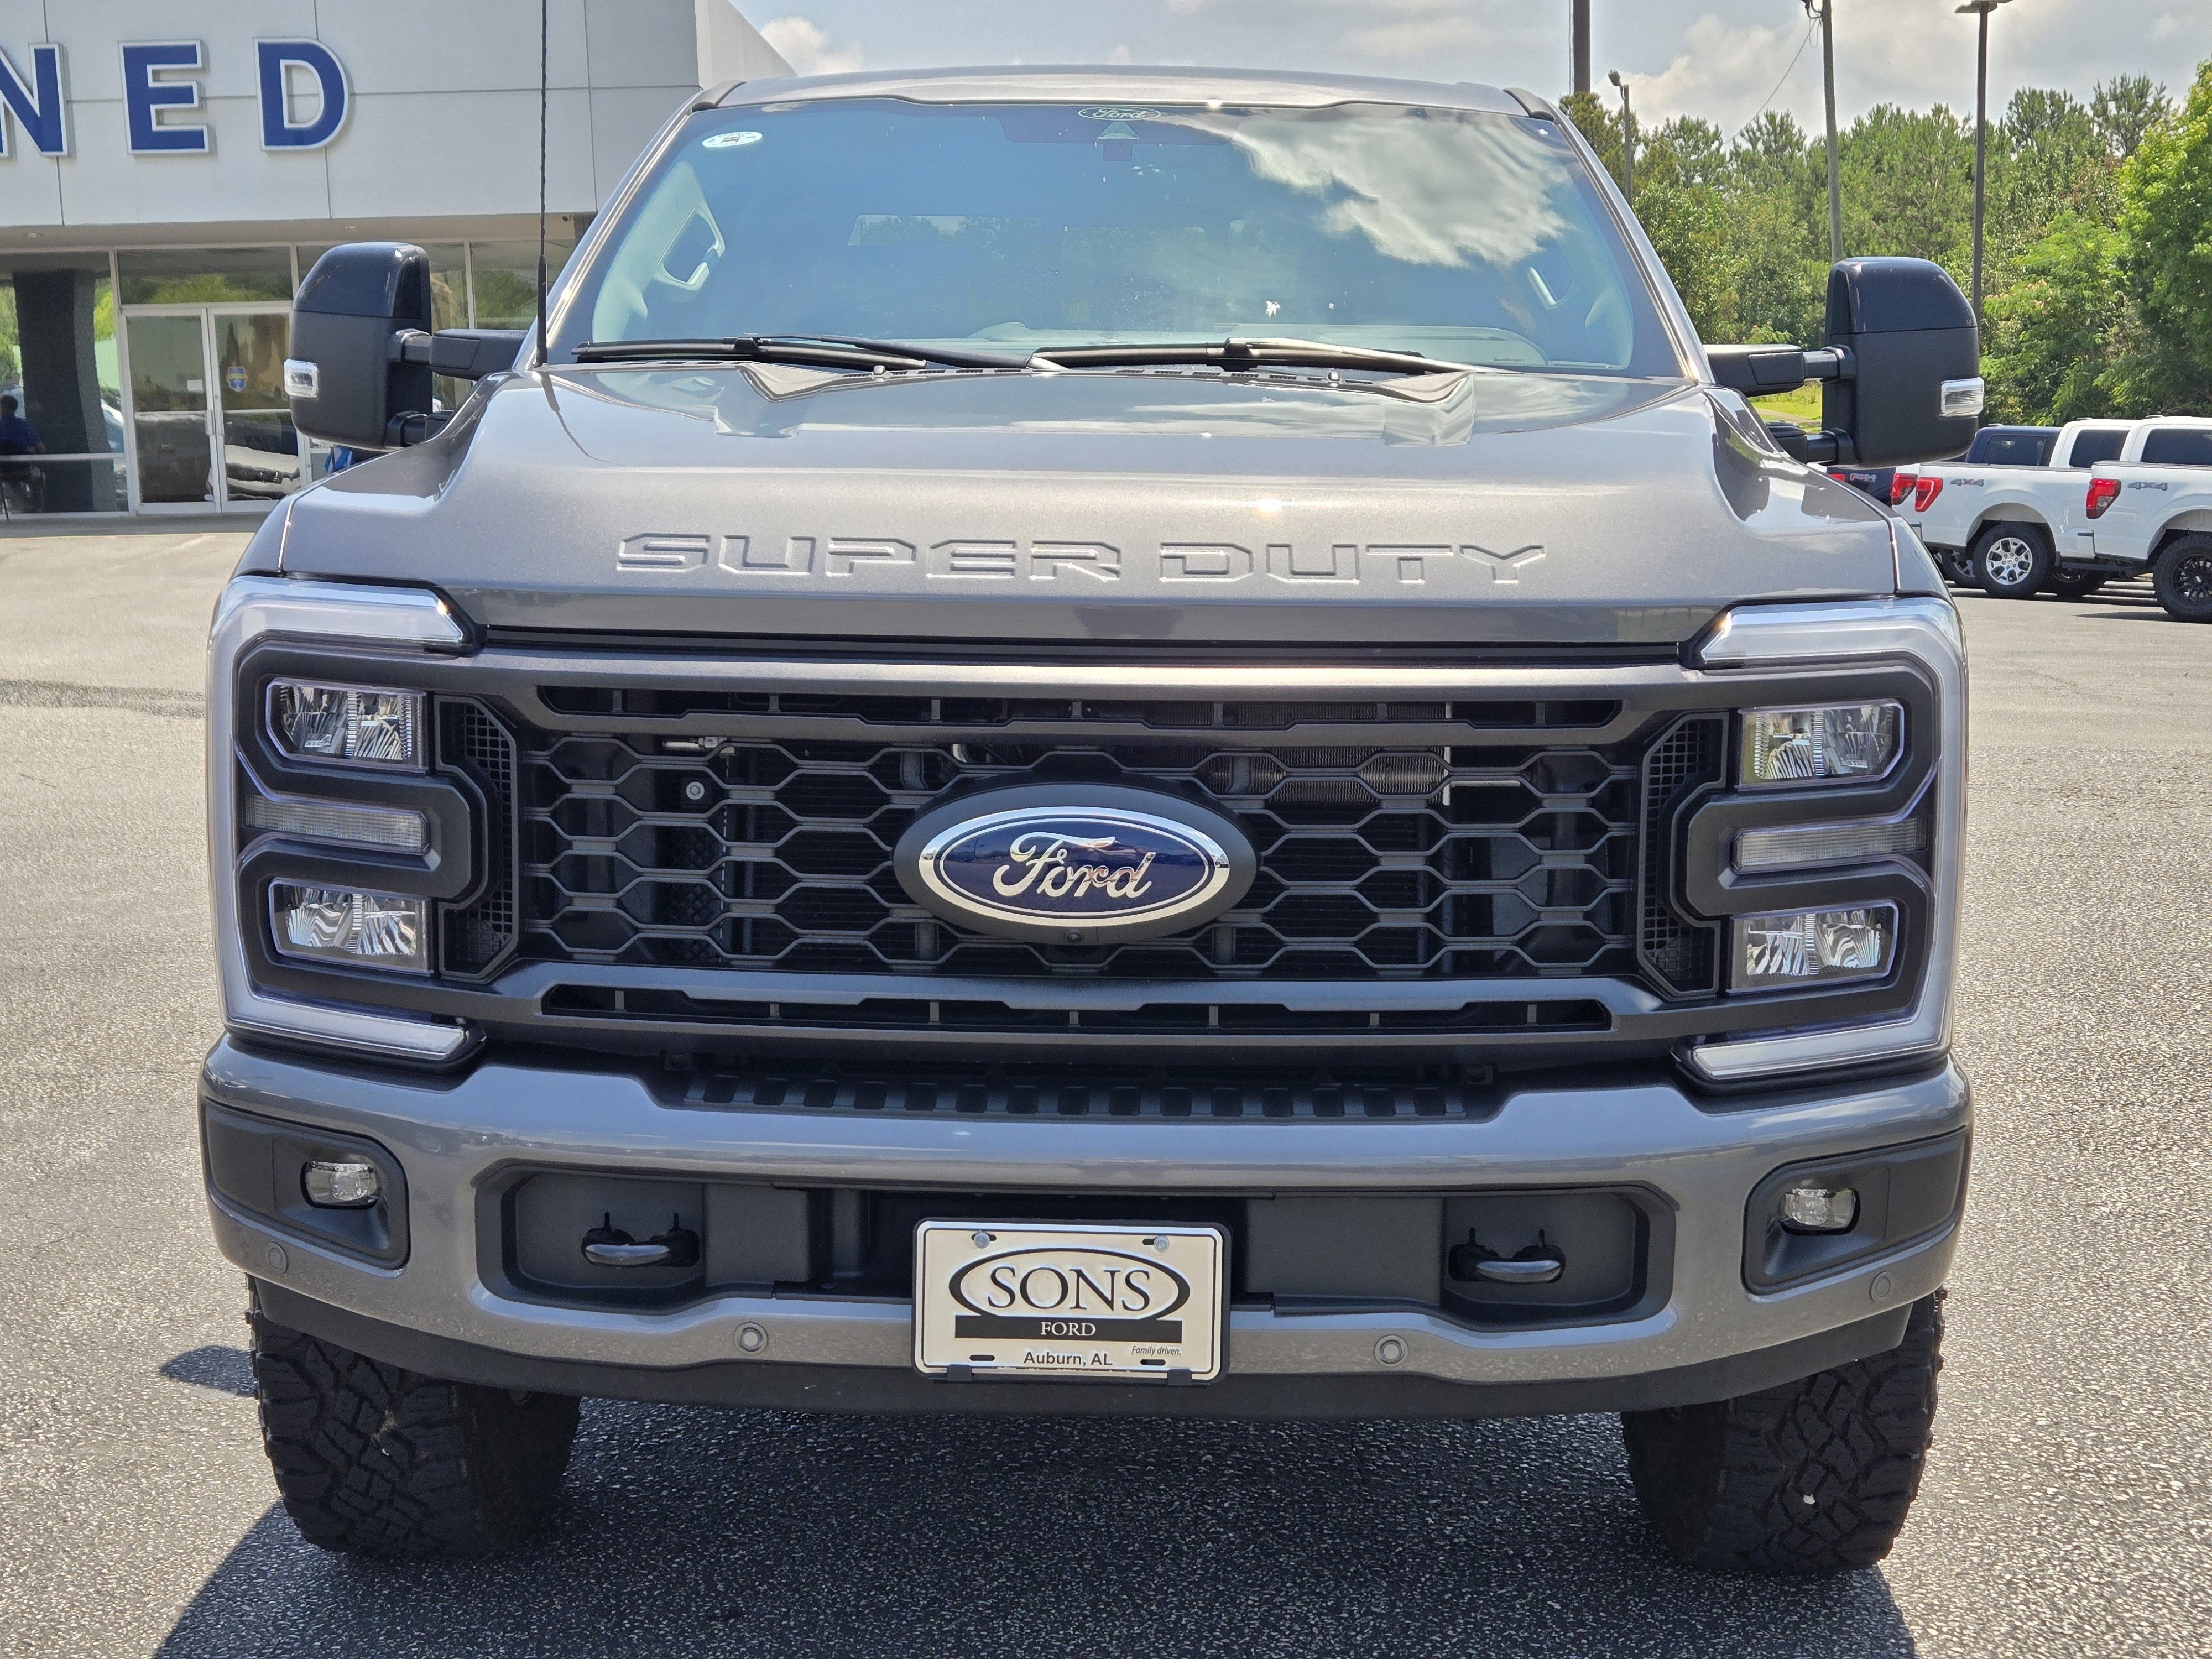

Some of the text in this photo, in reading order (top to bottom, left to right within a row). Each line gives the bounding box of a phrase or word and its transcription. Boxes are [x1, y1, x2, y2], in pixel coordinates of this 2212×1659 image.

[1092, 107, 1146, 118] Ford
[616, 532, 1547, 585] SUPER DUTY
[993, 832, 1156, 898] Ford
[987, 1266, 1151, 1312] SONS
[1040, 1321, 1097, 1337] FORD
[1023, 1351, 1113, 1366] Auburn, AL
[1131, 1345, 1182, 1357] Family driven.
